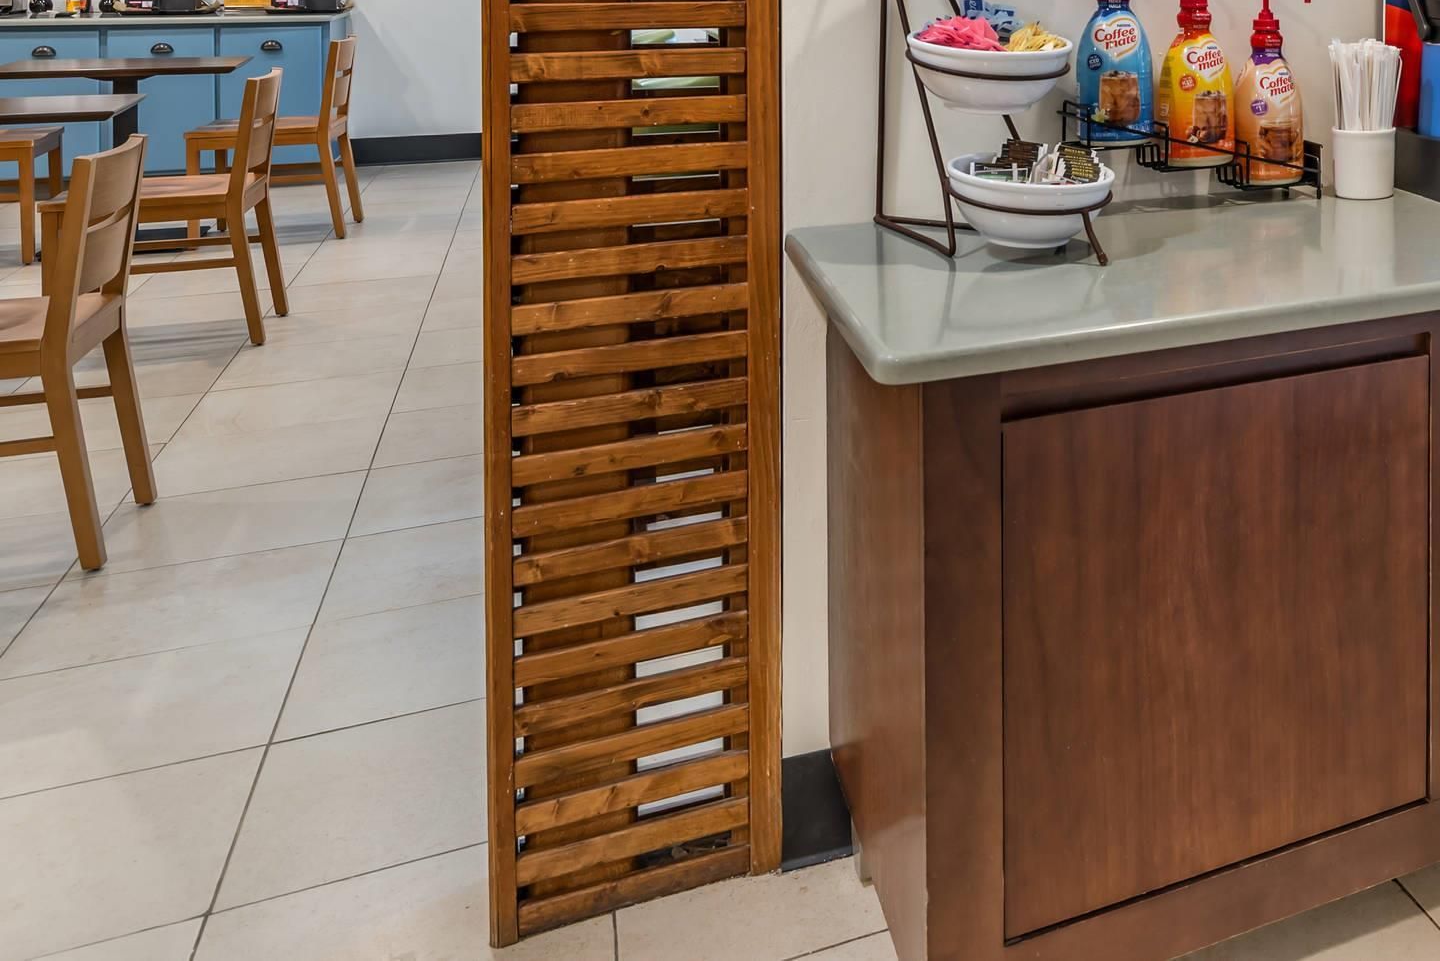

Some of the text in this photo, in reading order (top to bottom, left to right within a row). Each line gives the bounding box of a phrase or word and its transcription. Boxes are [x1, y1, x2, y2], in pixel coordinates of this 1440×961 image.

[1094, 27, 1135, 43] Coffee
[1105, 34, 1137, 50] mate
[1187, 49, 1222, 64] Coffee
[1198, 56, 1224, 71] mate
[1259, 76, 1292, 90] Coffee
[1270, 82, 1296, 97] mate
